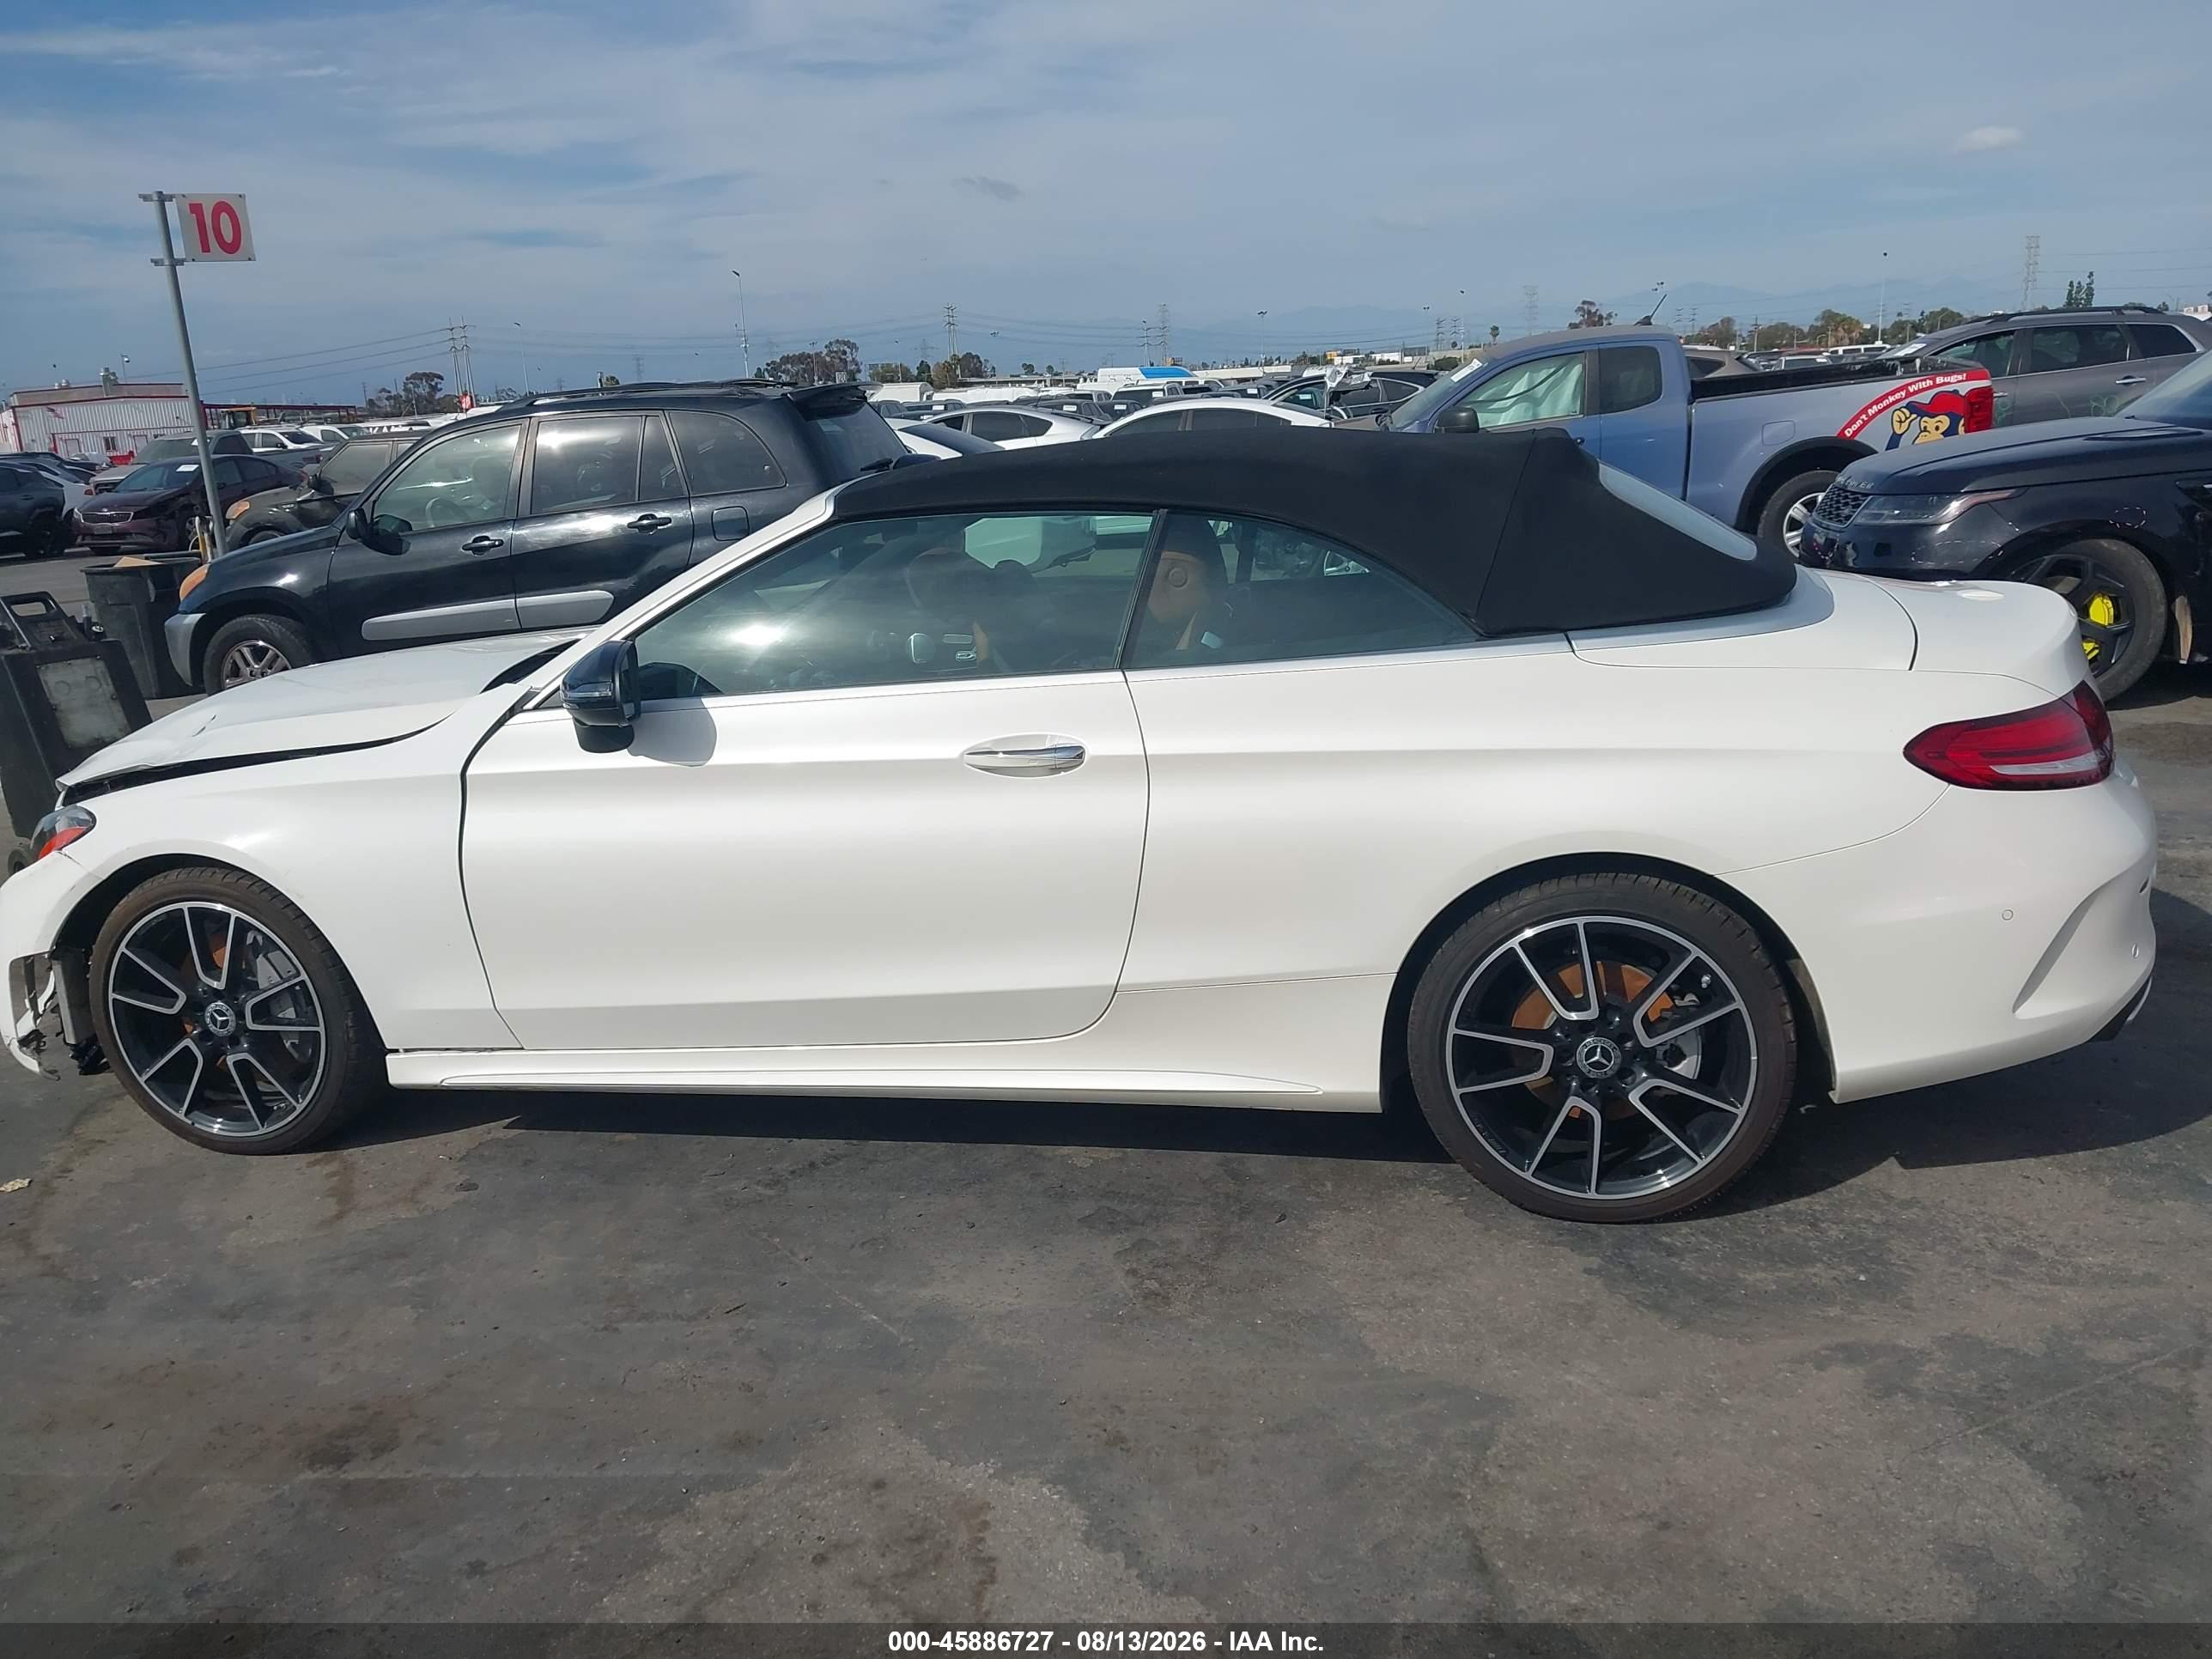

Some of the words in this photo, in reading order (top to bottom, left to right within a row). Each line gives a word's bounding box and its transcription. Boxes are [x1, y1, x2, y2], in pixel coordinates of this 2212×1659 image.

[188, 200, 242, 255] 10
[1844, 414, 1869, 437] Don't
[1867, 389, 1907, 416] Monkey
[1907, 379, 1934, 393] With
[1936, 373, 1967, 385] Bugs!
